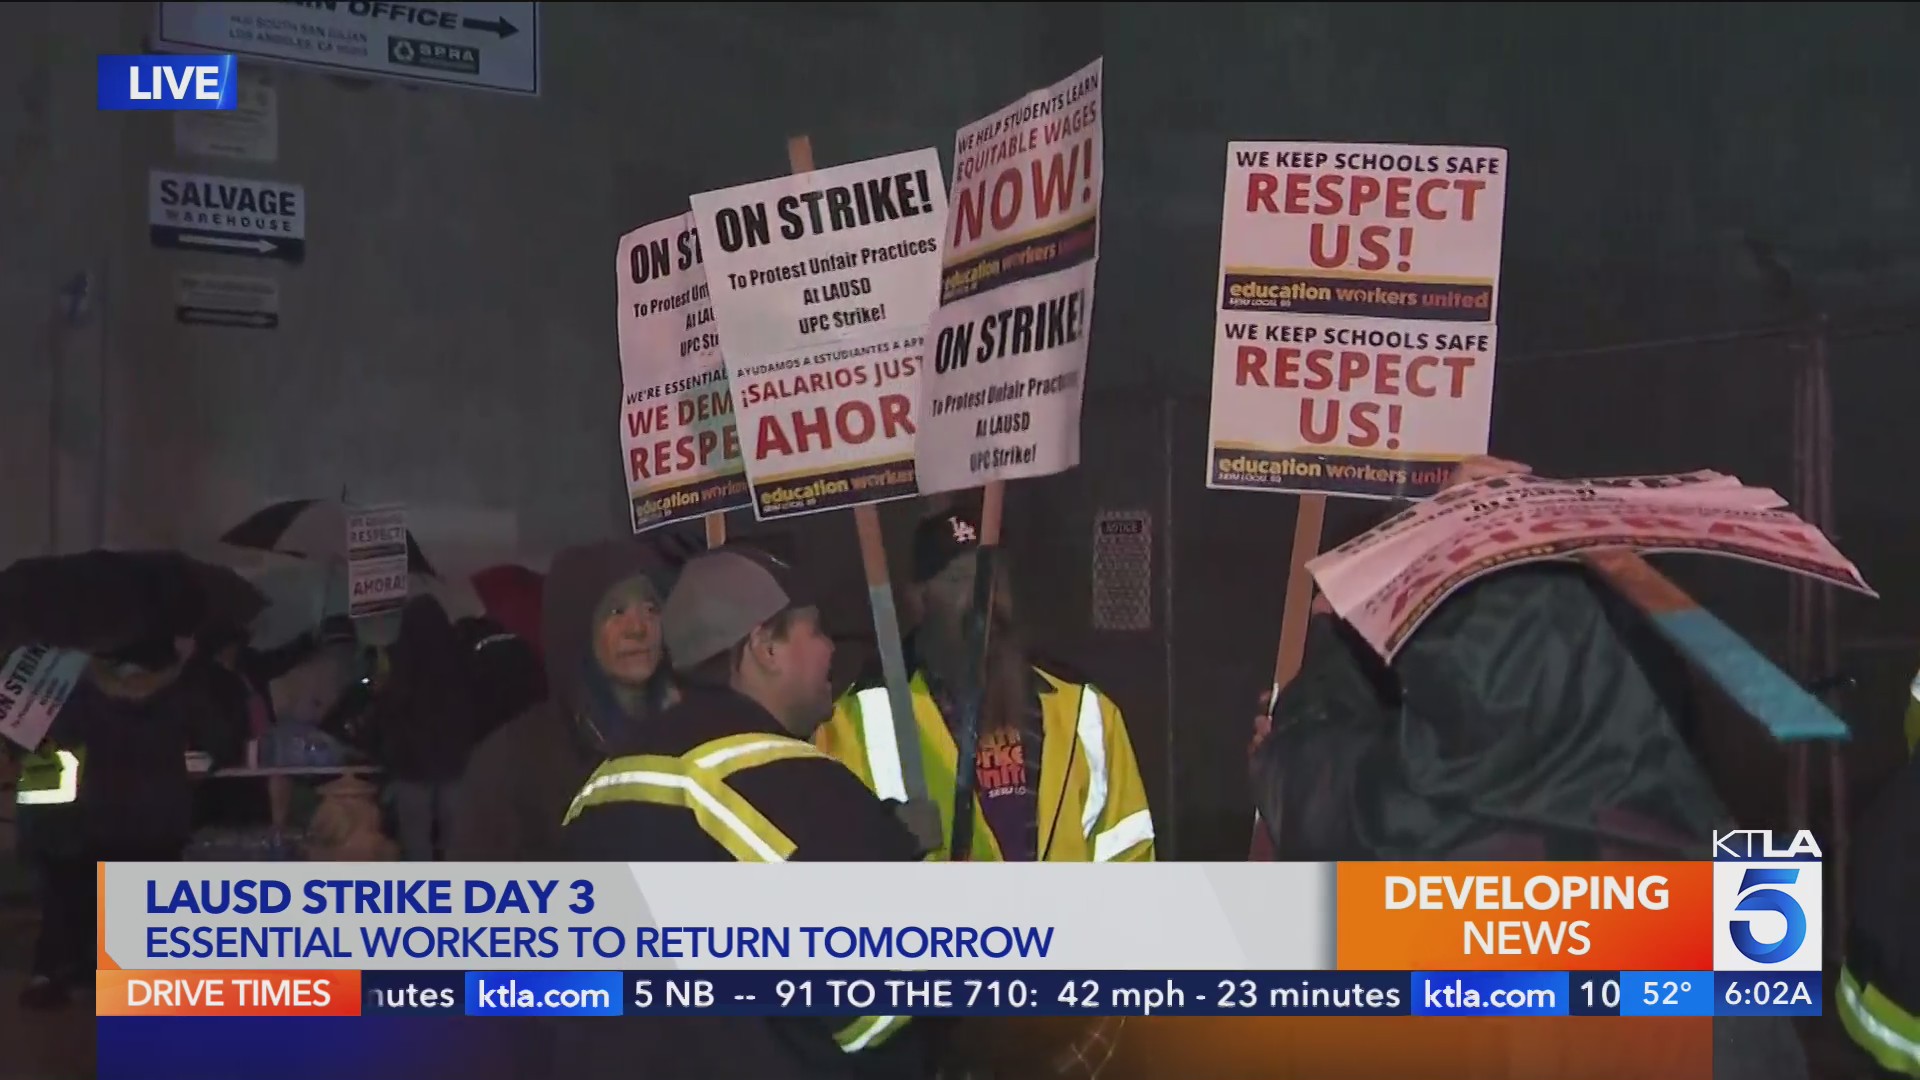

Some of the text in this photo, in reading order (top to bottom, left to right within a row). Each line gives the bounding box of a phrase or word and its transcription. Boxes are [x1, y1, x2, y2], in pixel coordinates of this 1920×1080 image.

[347, 2, 459, 29] OFFICE
[958, 72, 1099, 155] WE HELP STUDENTS LEARN
[957, 101, 1097, 182] EQUITABLE WAGES
[1236, 151, 1500, 174] WE KEEP SCHOOLS SAFE
[160, 179, 296, 217] SALVAGE
[715, 169, 934, 253] ON STRIKE!
[953, 137, 1093, 248] NOW!
[1246, 172, 1486, 221] RESPECT
[165, 209, 292, 232] WAREHOUSE
[630, 237, 671, 285] ON
[727, 237, 938, 291] To Protest Unfair Practices
[1309, 223, 1414, 273] US!
[633, 303, 648, 318] To
[650, 290, 691, 315] Protest
[803, 278, 872, 306] At LAUSD
[1229, 281, 1490, 309] education workers united
[798, 304, 887, 335] UPC Strike!
[934, 288, 1085, 375] ON STRIKE!
[1225, 323, 1490, 352] WE KEEP SCHOOLS SAFE
[680, 337, 701, 357] UPC
[737, 357, 801, 378] AYUDAMOS
[803, 356, 812, 366] A
[814, 341, 890, 364] ESTUDIANTES
[892, 341, 900, 350] A
[626, 368, 729, 405] WE'RE ESSENTIAL
[741, 365, 868, 408] ¡SALARIOS
[1235, 345, 1476, 398] RESPECT
[944, 389, 985, 416] Protest
[627, 405, 669, 438] WE
[755, 394, 917, 460] AHOR
[989, 411, 1031, 435] LAUSD
[1300, 397, 1403, 450] US!
[630, 425, 741, 482] RESPE
[970, 443, 1038, 474] UPC Strike!
[1219, 456, 1322, 478] education
[1325, 464, 1408, 485] workers
[761, 479, 850, 505] education
